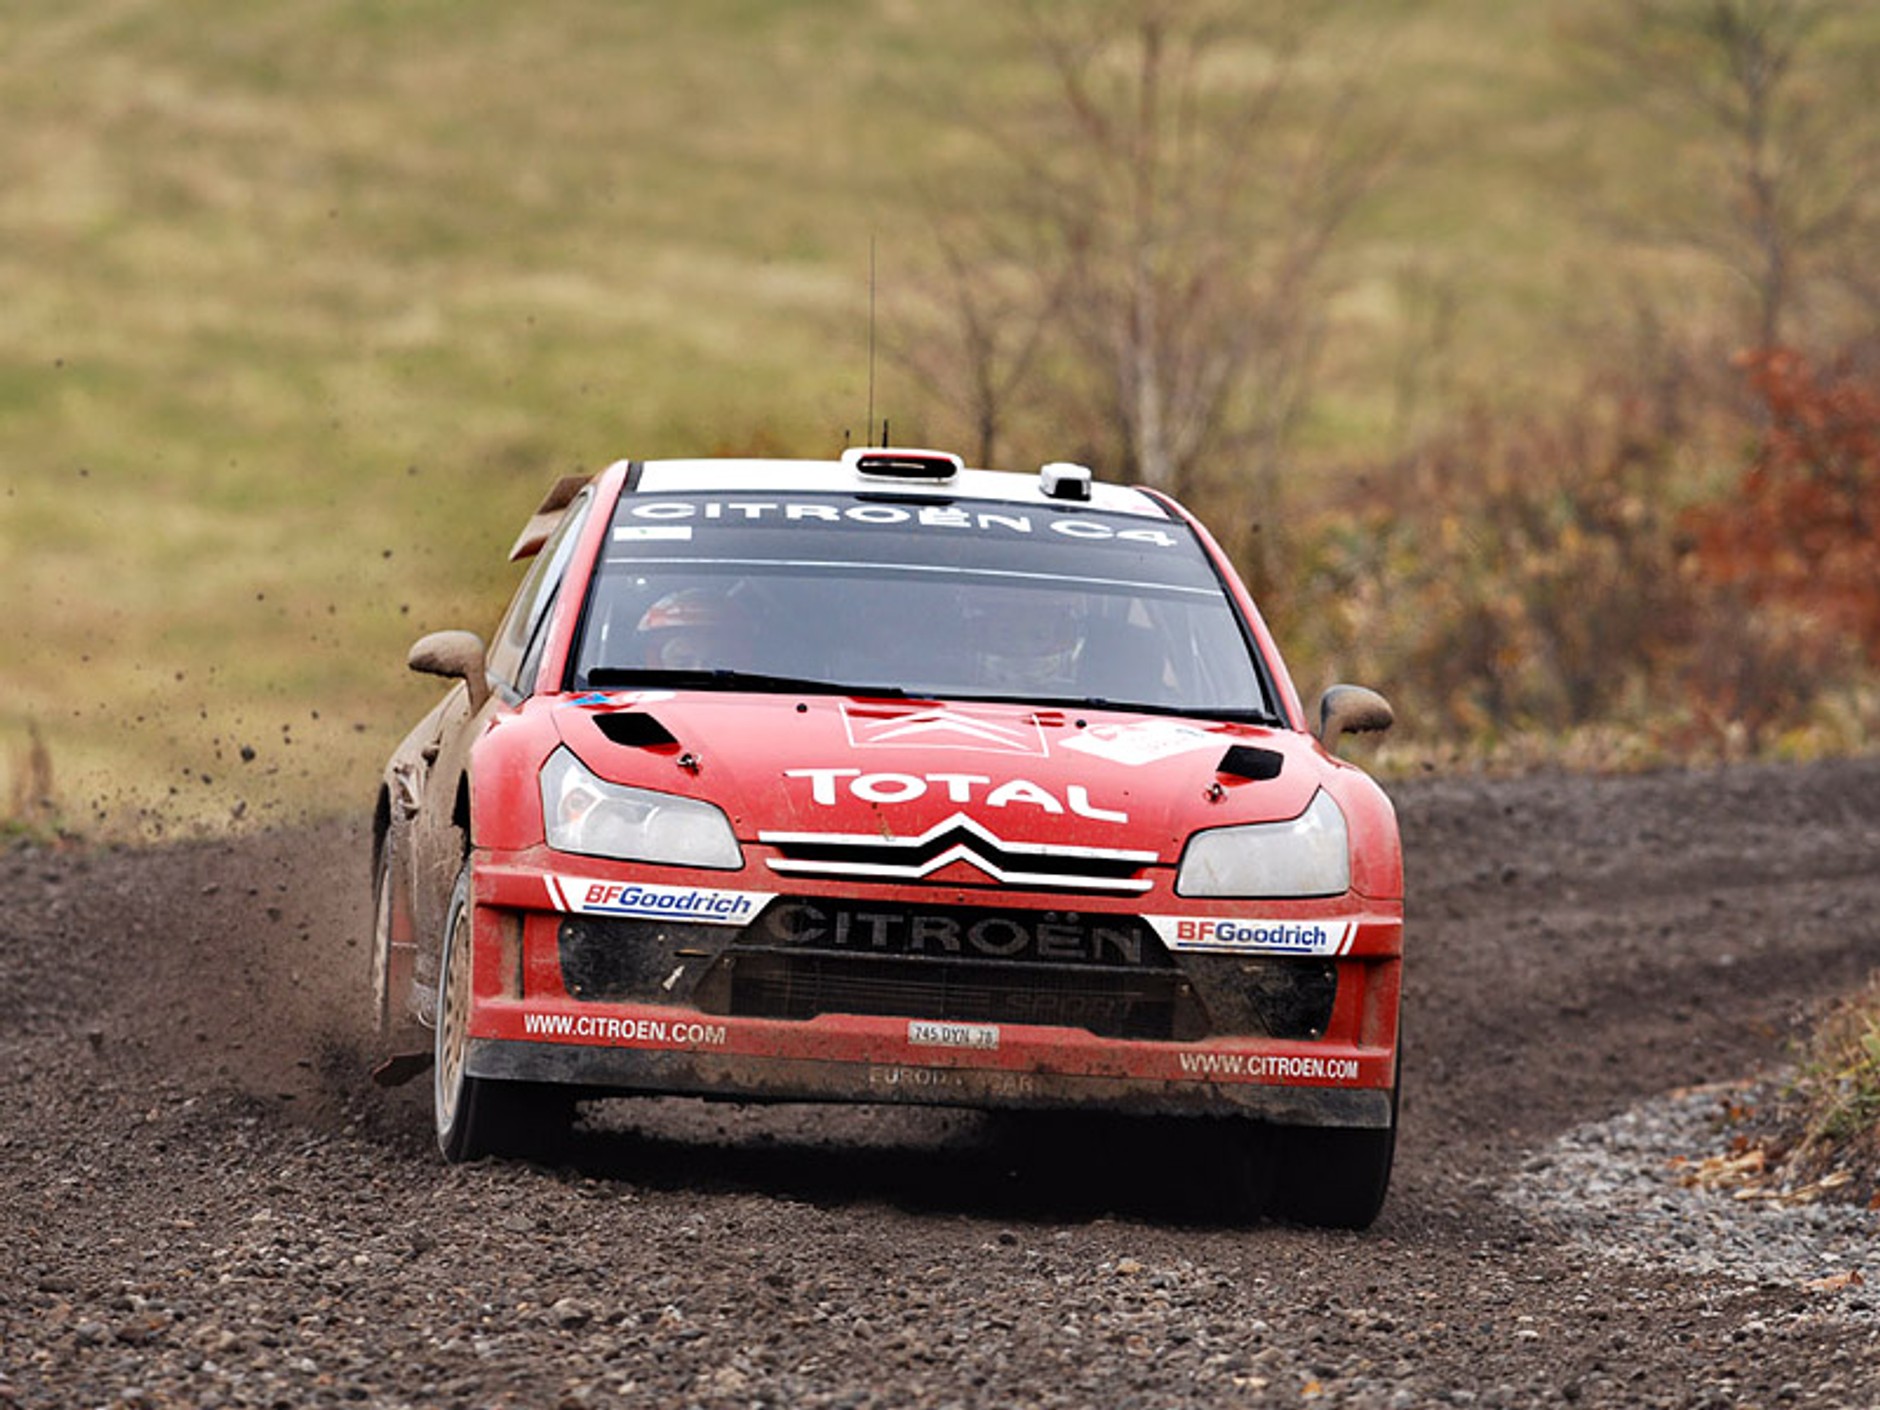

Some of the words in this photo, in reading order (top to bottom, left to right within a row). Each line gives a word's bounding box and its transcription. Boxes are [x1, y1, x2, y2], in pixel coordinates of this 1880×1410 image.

[631, 503, 1031, 532] CITROËN
[1048, 519, 1178, 546] C4
[785, 769, 1128, 823] TOTAL
[585, 884, 751, 913] BFGoodrich
[765, 902, 1142, 963] CITROËN
[1177, 921, 1326, 945] BFGoodrich
[524, 1014, 726, 1044] WWW.CITROEN.COM
[915, 1026, 938, 1041] 745
[1179, 1053, 1358, 1079] WWW.CITROEN.COM
